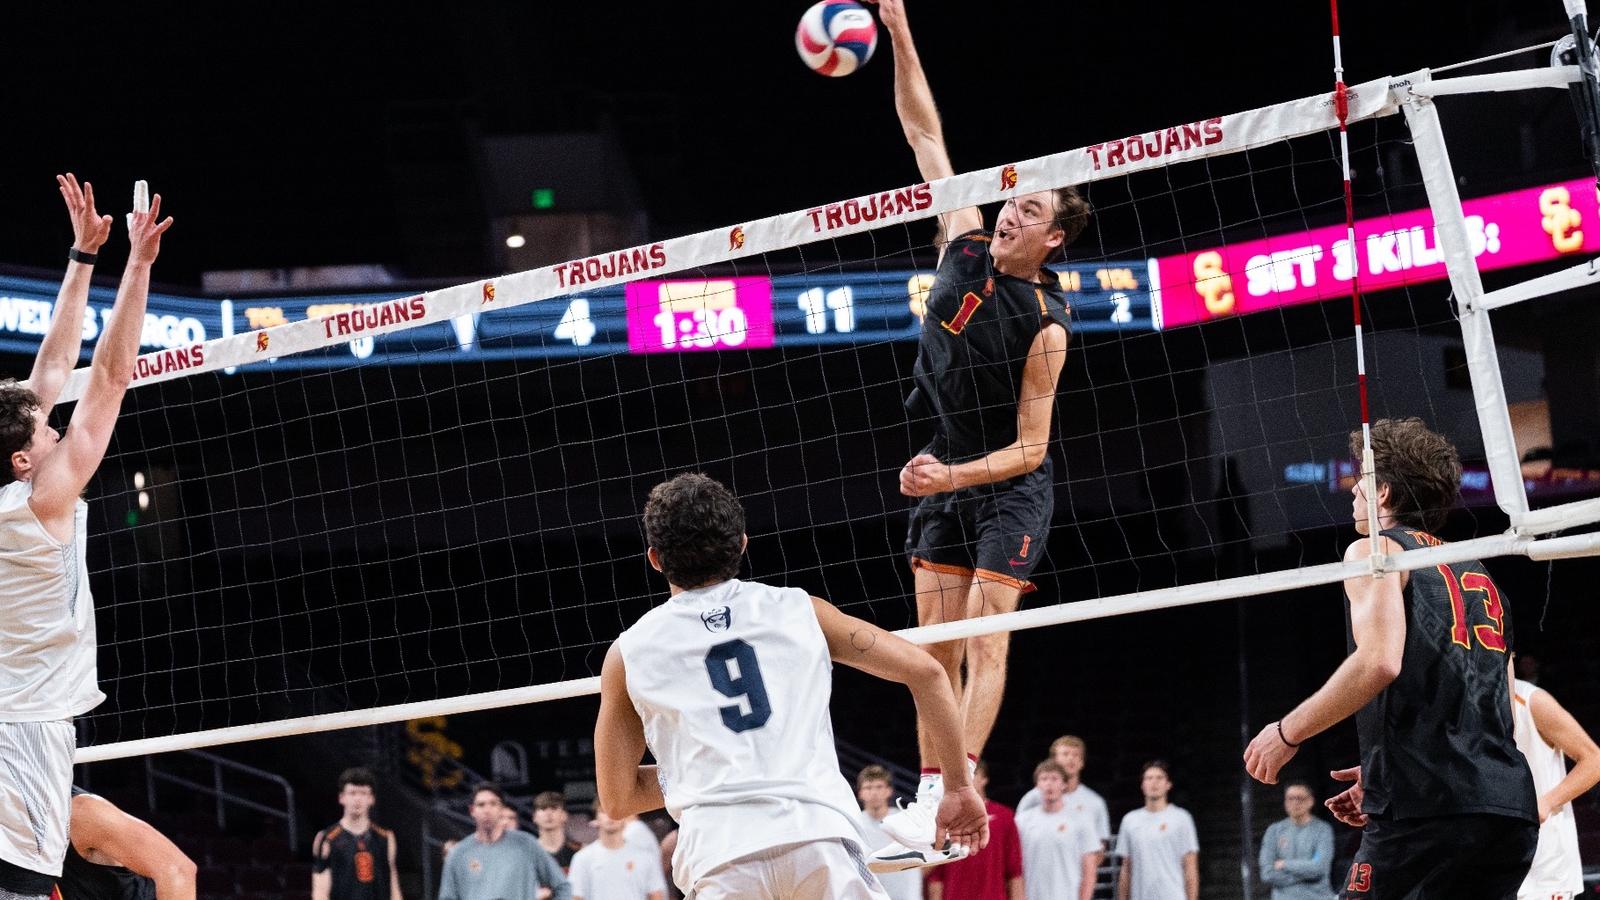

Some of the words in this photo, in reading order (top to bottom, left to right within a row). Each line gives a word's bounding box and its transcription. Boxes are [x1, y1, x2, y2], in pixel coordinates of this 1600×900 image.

[1388, 79, 1411, 90] enoh
[1086, 117, 1223, 171] TROJANS
[807, 183, 934, 232] TROJANS
[553, 243, 667, 288] TROJANS
[1245, 246, 1322, 296] SET
[1366, 215, 1500, 275] KILS:
[0, 296, 98, 340] WELS
[321, 297, 426, 338] TROJANS
[554, 298, 596, 346] 4
[798, 286, 856, 334] 11
[941, 292, 983, 335] 1
[131, 344, 204, 379] OJANS
[1437, 563, 1507, 653] 13
[704, 638, 772, 734] 9
[1347, 862, 1373, 893] 13
